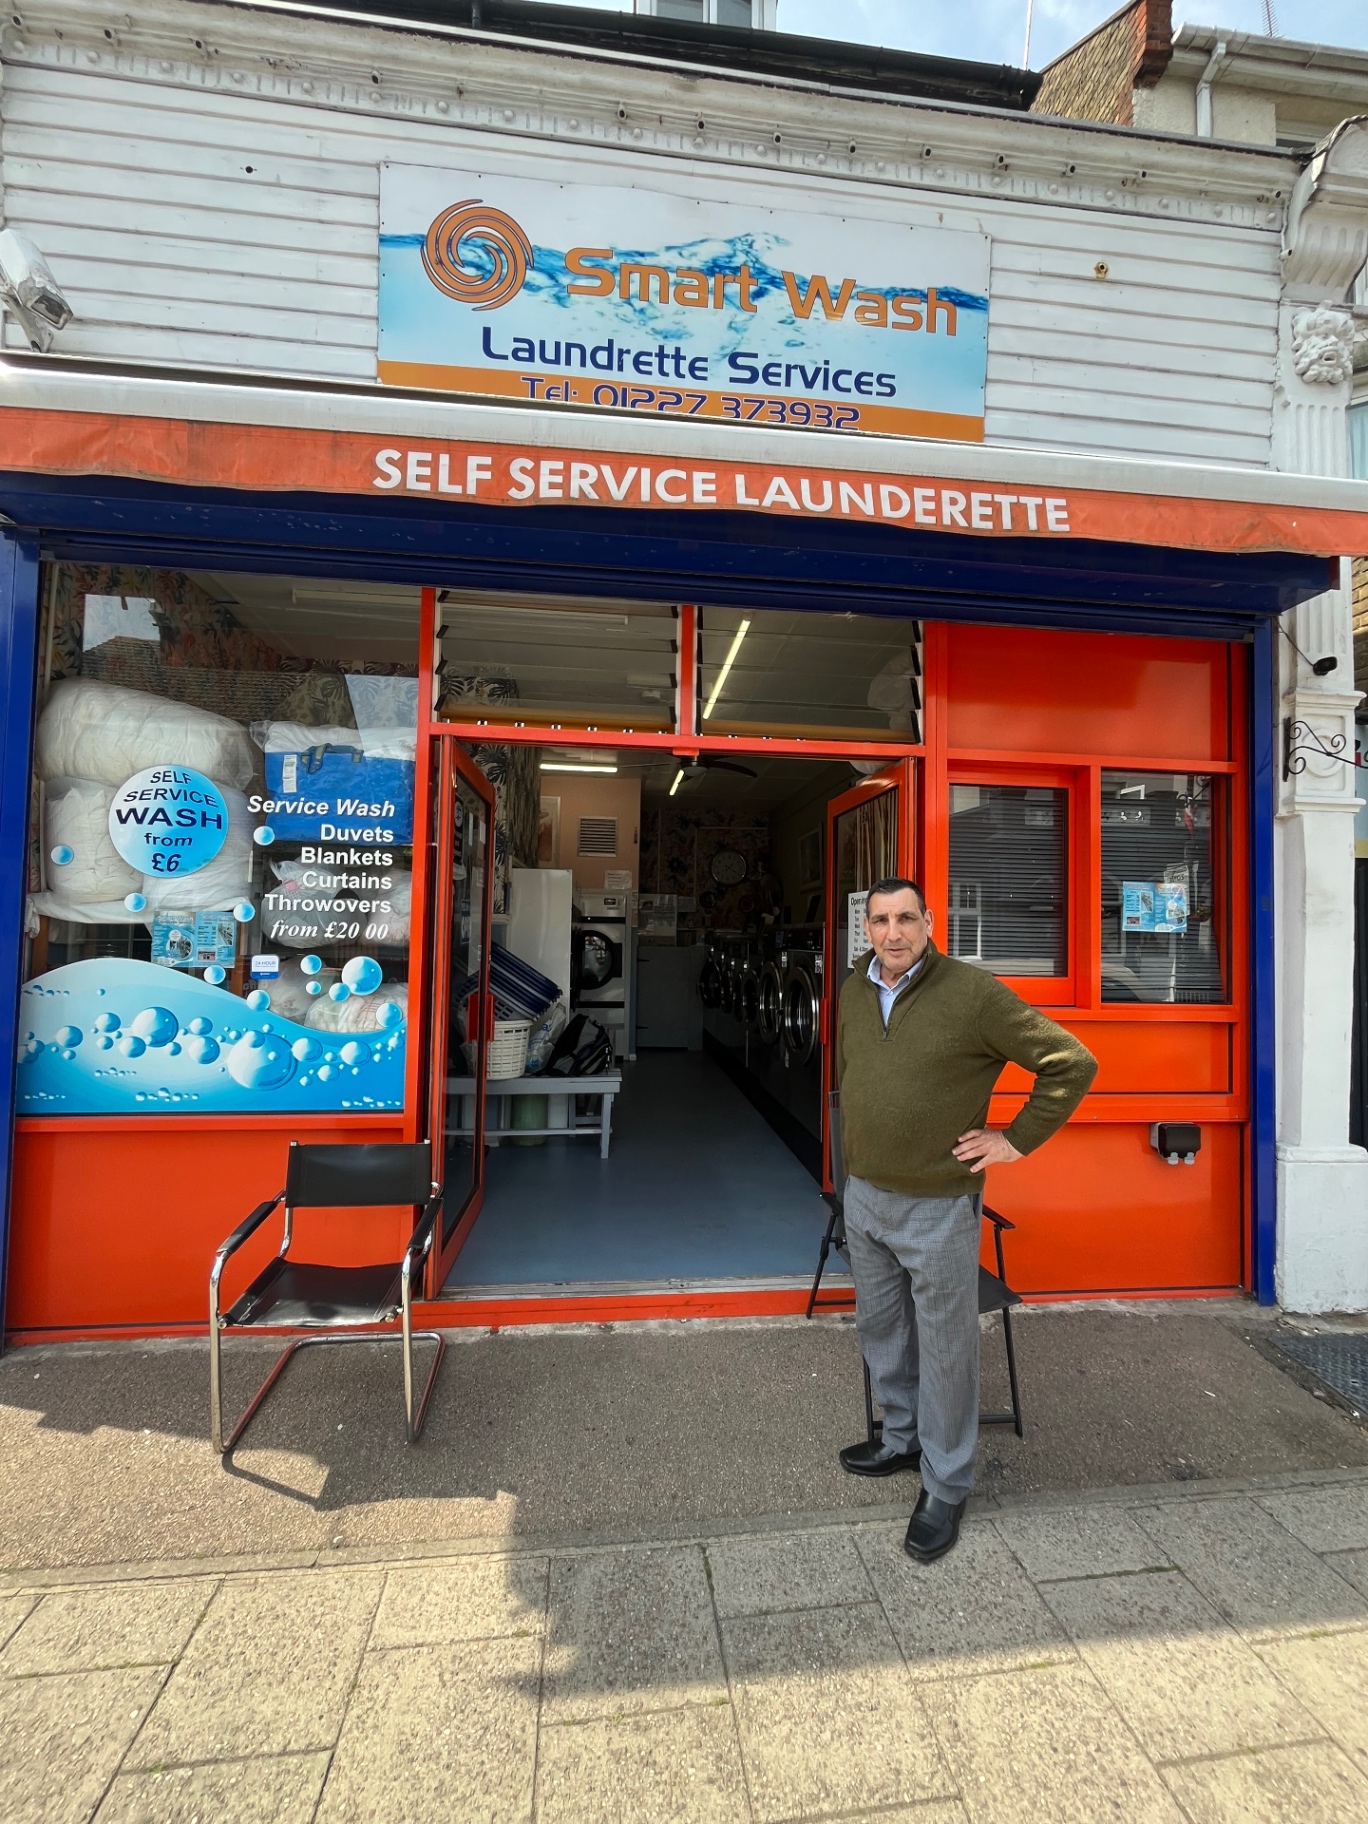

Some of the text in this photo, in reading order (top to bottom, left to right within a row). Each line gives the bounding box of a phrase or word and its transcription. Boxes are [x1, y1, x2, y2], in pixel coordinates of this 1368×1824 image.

[565, 247, 958, 337] Smart Wash
[482, 326, 897, 398] Laundrette Services
[592, 384, 708, 415] 01227
[721, 396, 861, 431] 373932
[372, 449, 1071, 532] SELF SERVICE LAUNDERETTE
[150, 770, 192, 784] SELF
[123, 788, 219, 808] SERVICE
[247, 795, 395, 817] Service Wash
[116, 807, 222, 830] WASH
[144, 832, 193, 847] from
[320, 823, 394, 843] Duvets
[151, 852, 182, 872] £6
[301, 846, 393, 866] Blankets
[302, 871, 392, 890] Curtains
[264, 893, 391, 914] Throwovers
[270, 920, 318, 940] from
